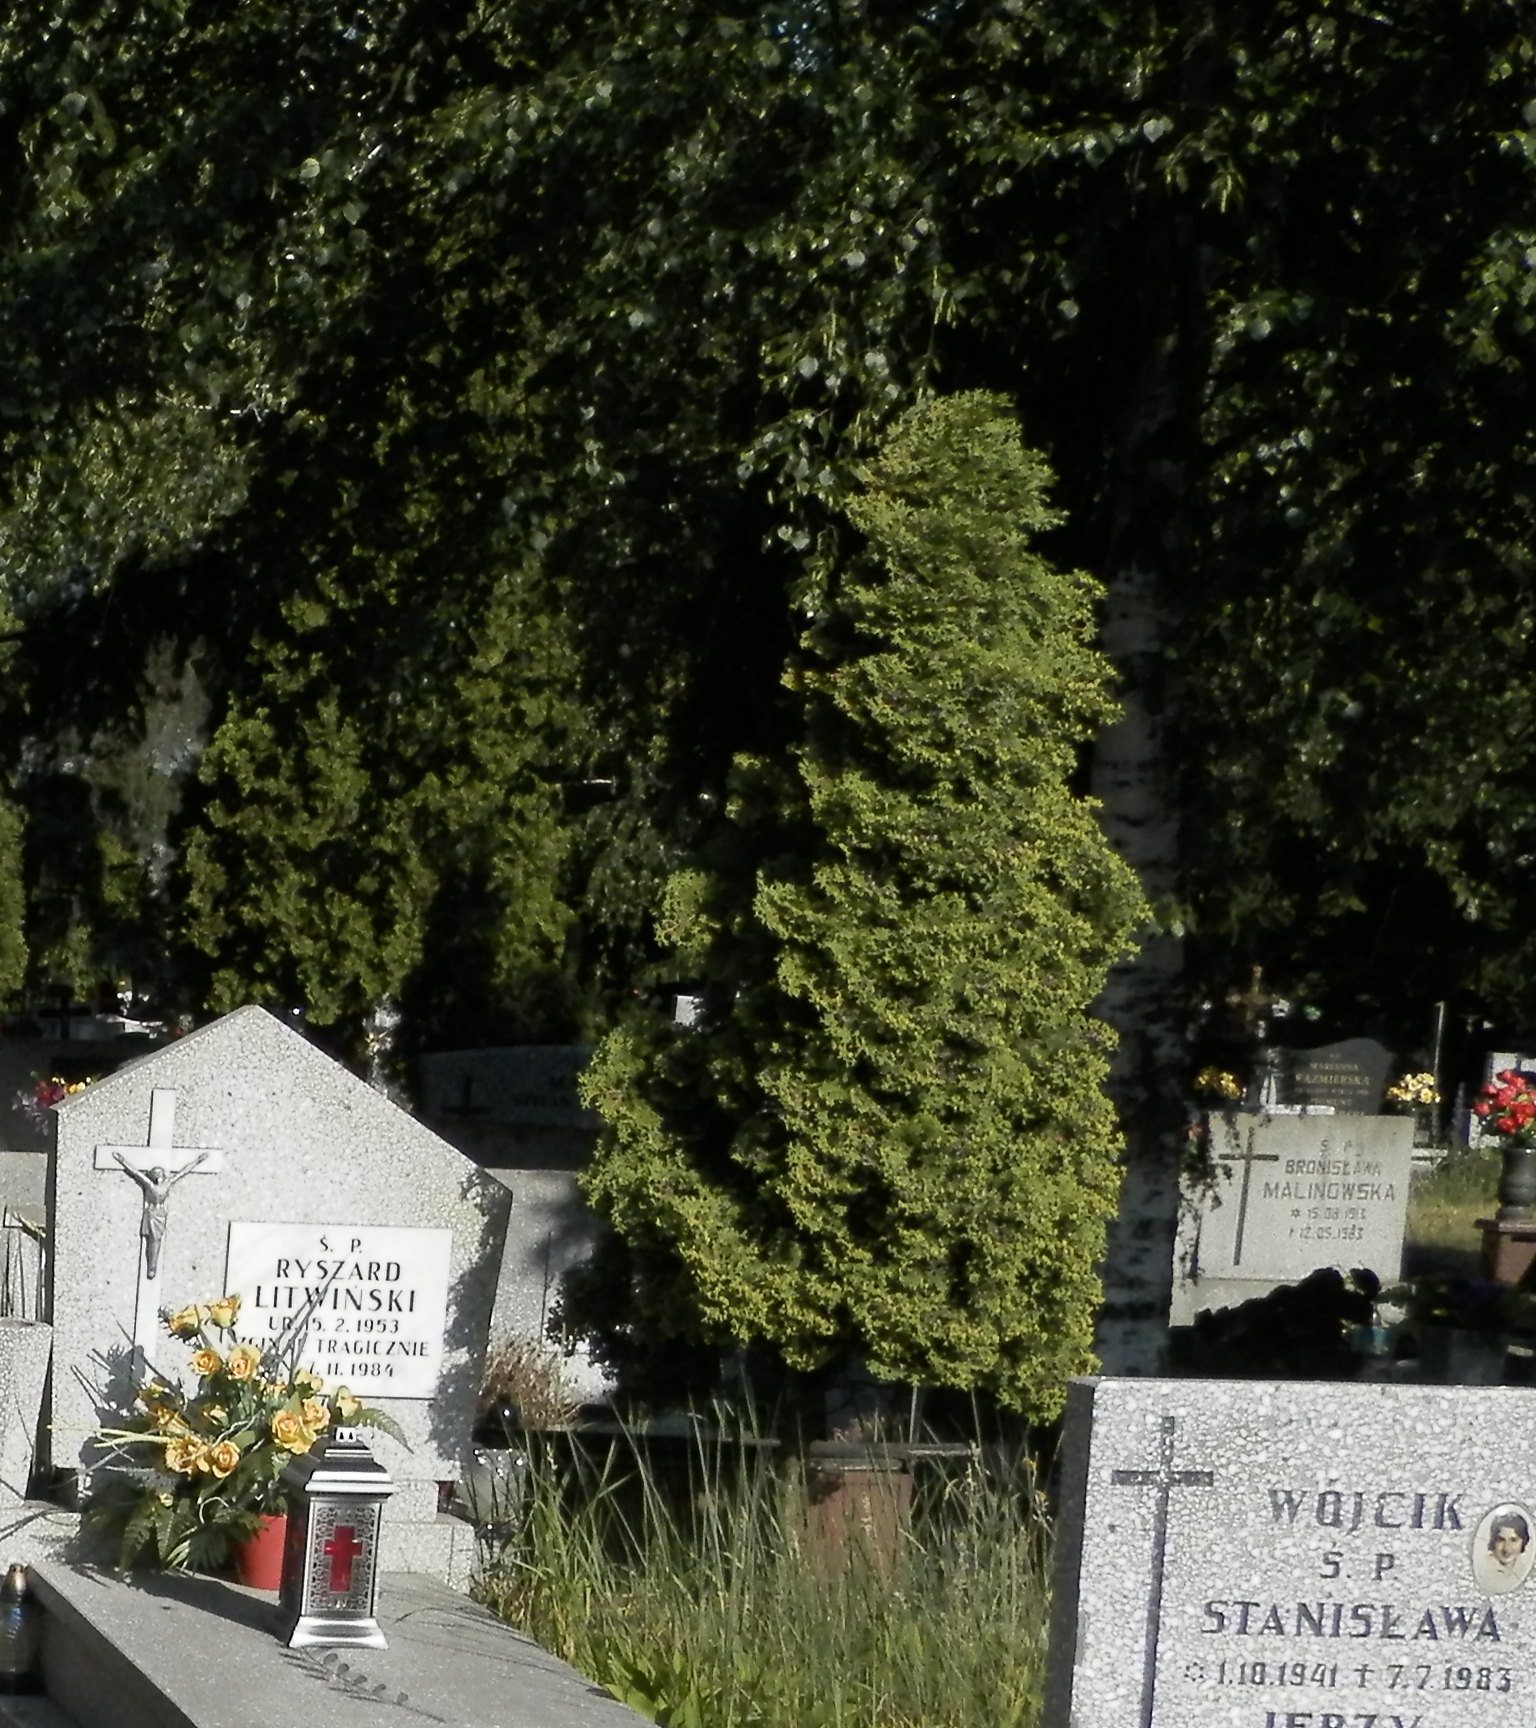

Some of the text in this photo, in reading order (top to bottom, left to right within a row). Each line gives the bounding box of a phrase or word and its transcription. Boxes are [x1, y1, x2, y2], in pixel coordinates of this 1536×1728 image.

[1263, 1182, 1395, 1201] MALINOWSKA
[277, 1259, 400, 1282] RYSZARD
[255, 1284, 415, 1313] LITWIŃSKI
[317, 1339, 429, 1357] TRAGICZNIE
[1269, 1482, 1463, 1533] WÓJCIK
[1200, 1600, 1502, 1643] STANISŁAWA
